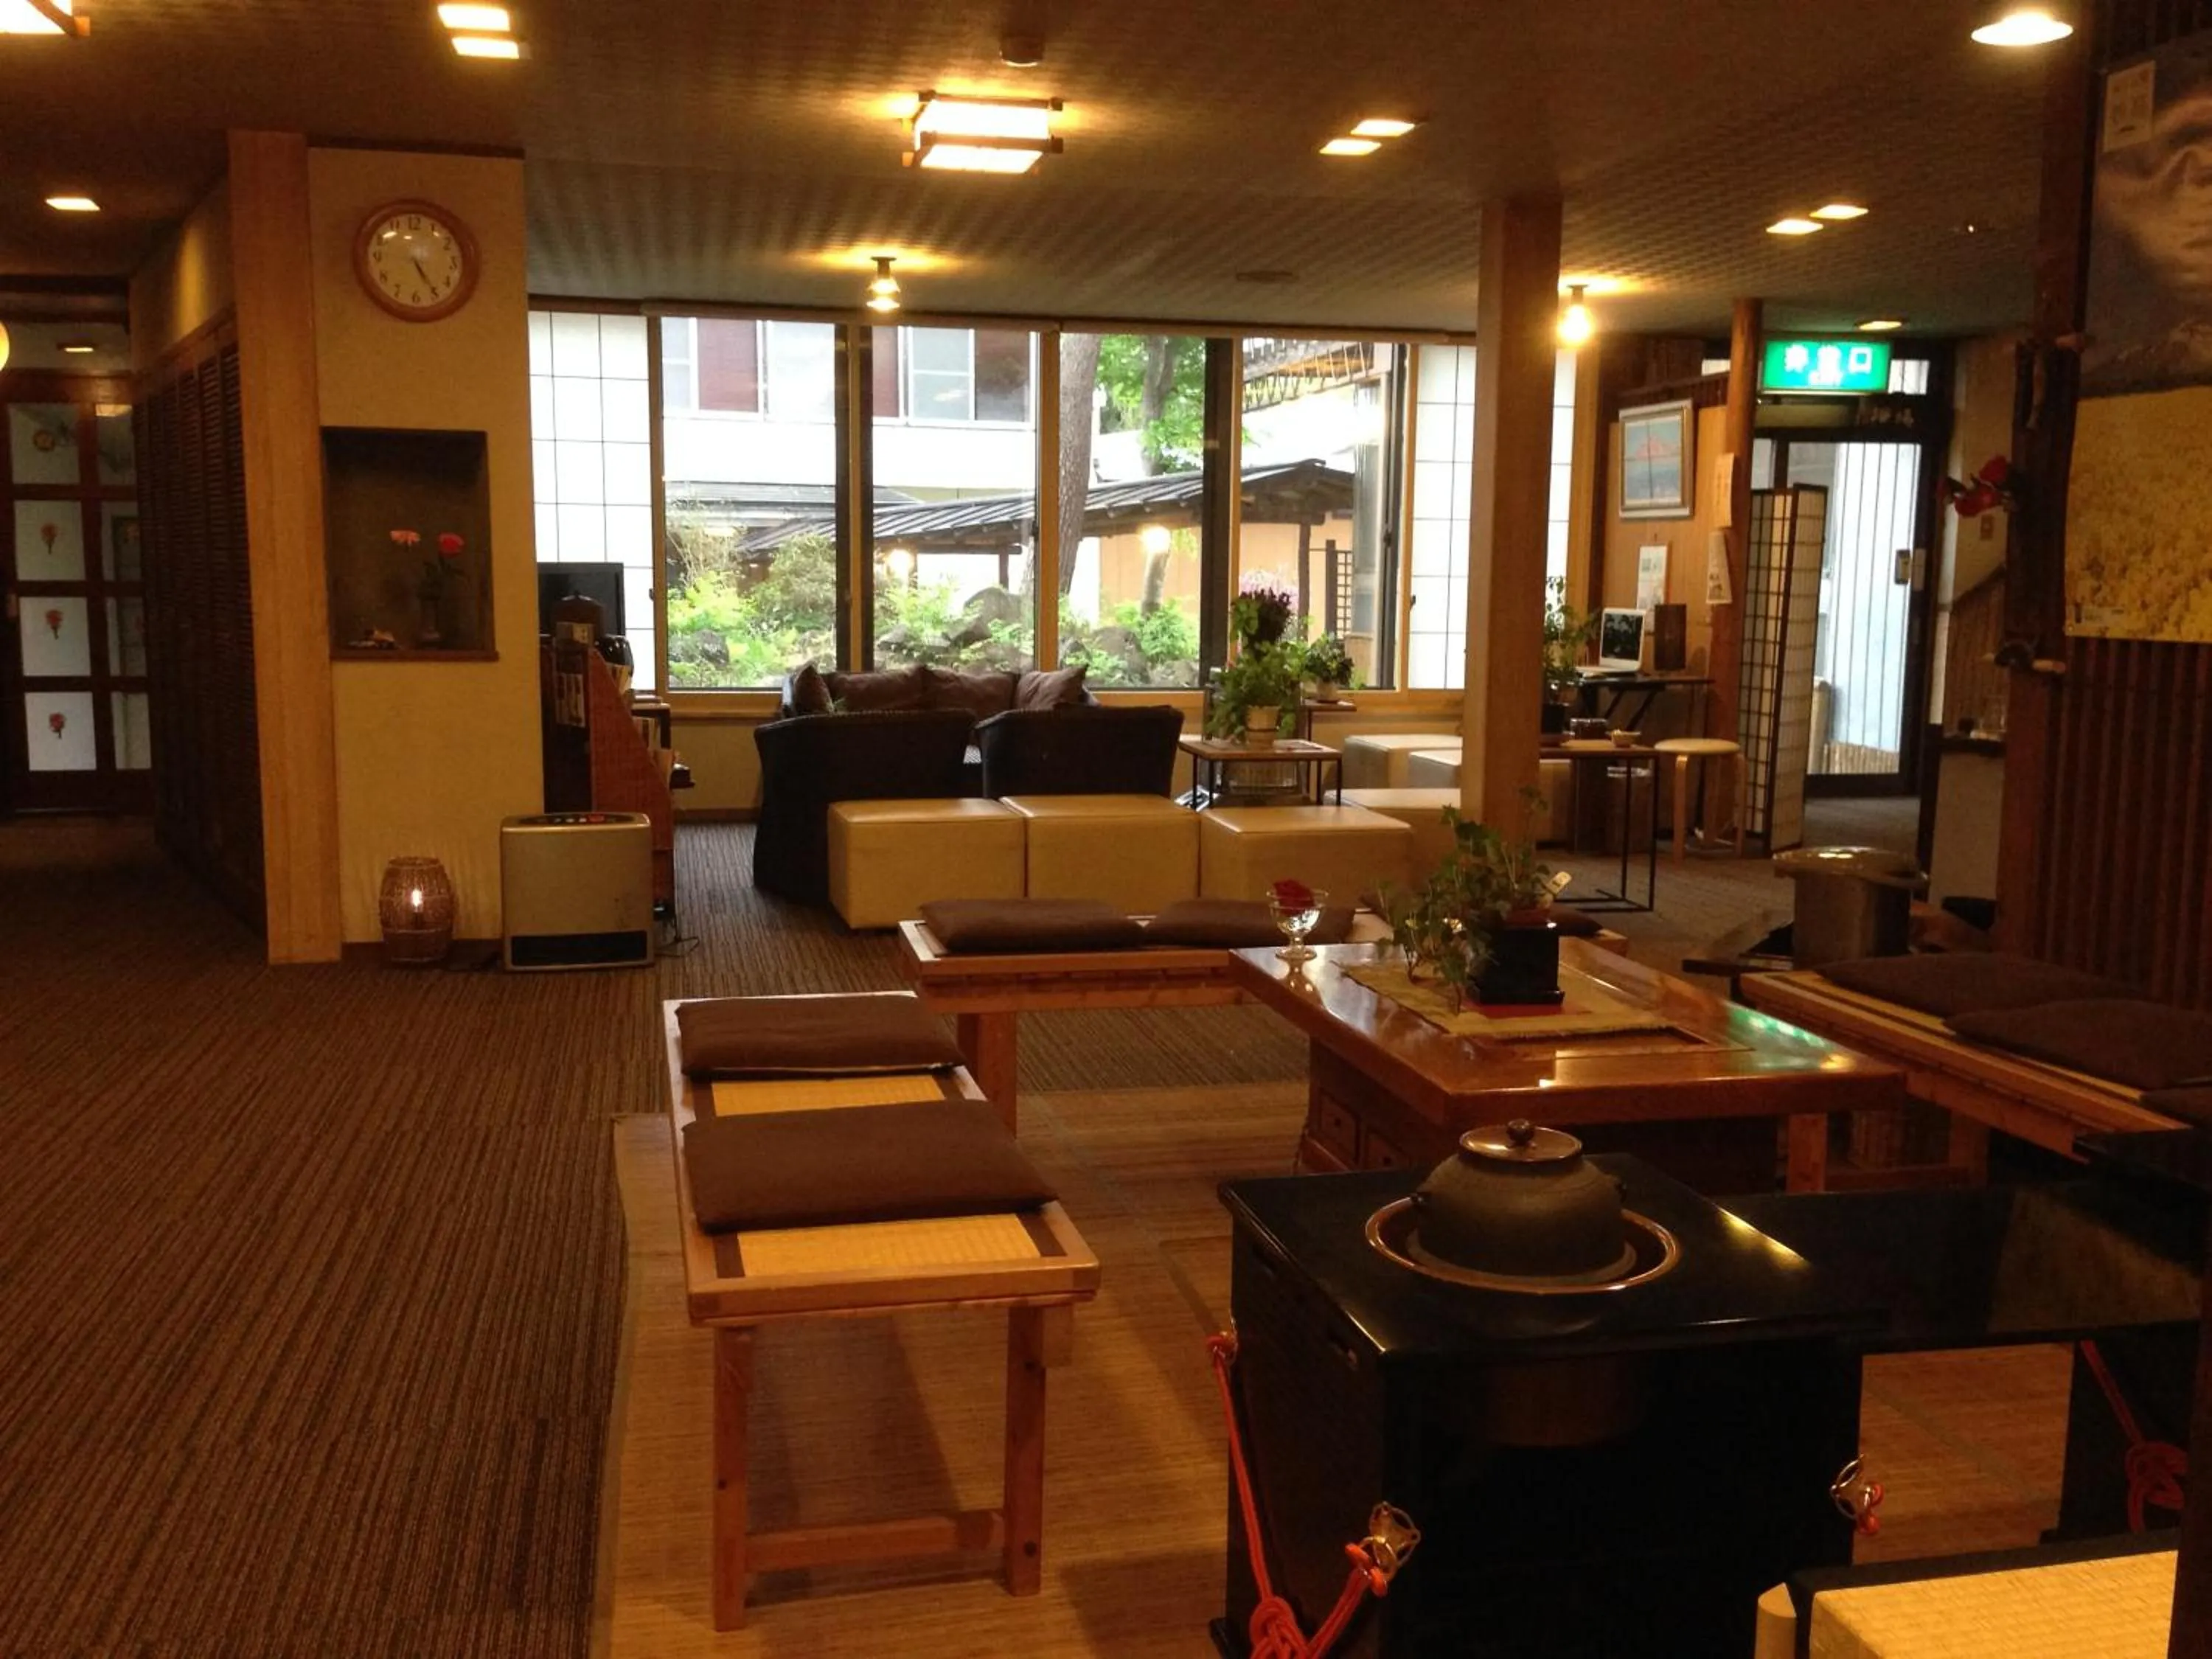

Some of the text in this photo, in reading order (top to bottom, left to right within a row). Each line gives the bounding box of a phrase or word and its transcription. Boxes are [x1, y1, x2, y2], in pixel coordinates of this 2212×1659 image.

[408, 217, 421, 230] 12
[442, 237, 451, 251] 2
[372, 251, 382, 262] 9
[448, 256, 457, 270] 3
[442, 275, 451, 288] 4
[394, 285, 401, 298] 7
[412, 290, 421, 303] 6
